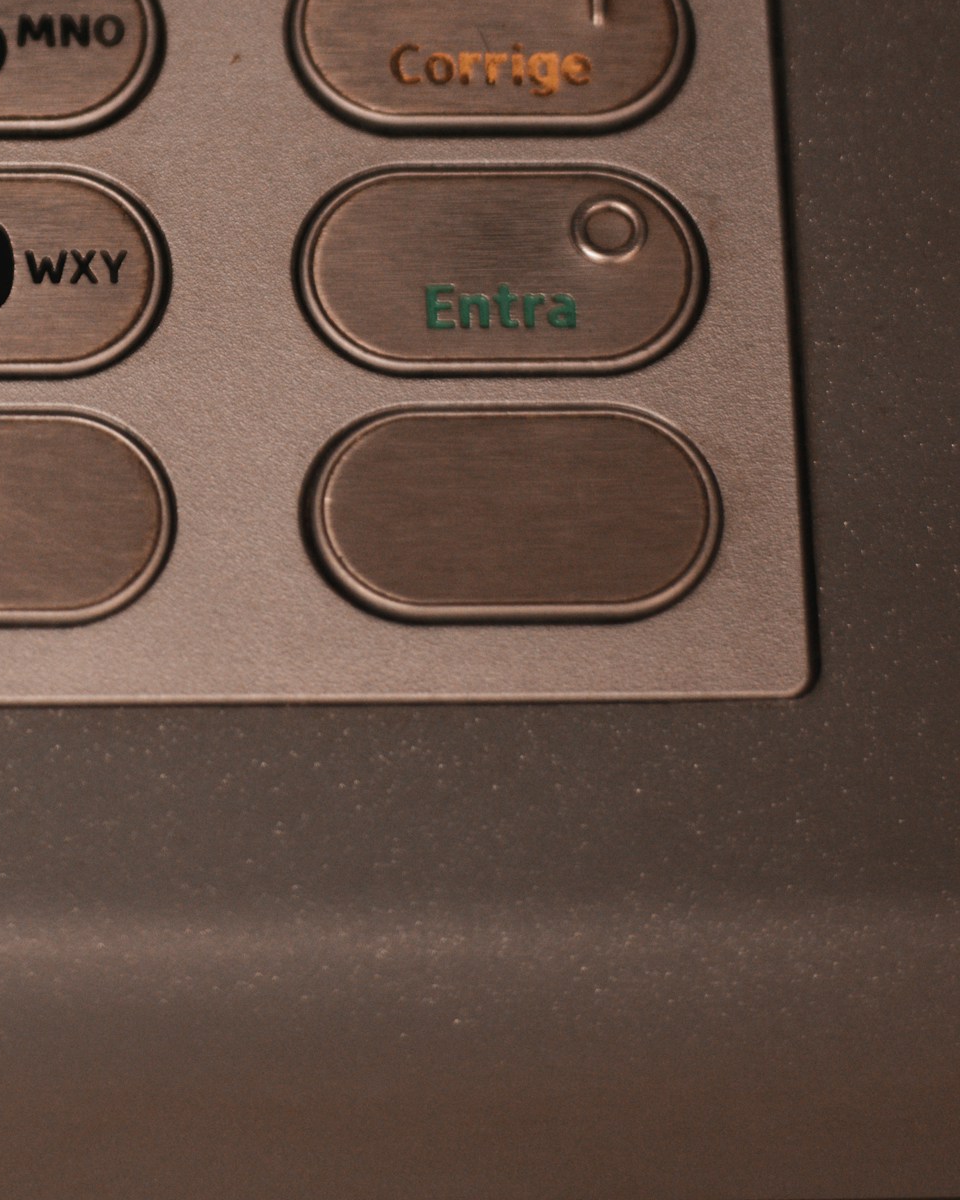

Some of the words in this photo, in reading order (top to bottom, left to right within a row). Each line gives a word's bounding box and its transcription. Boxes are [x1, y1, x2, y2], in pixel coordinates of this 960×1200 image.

[16, 13, 126, 48] MNO
[389, 43, 592, 97] Corrige
[24, 249, 128, 285] WXY
[424, 282, 578, 330] Entra
